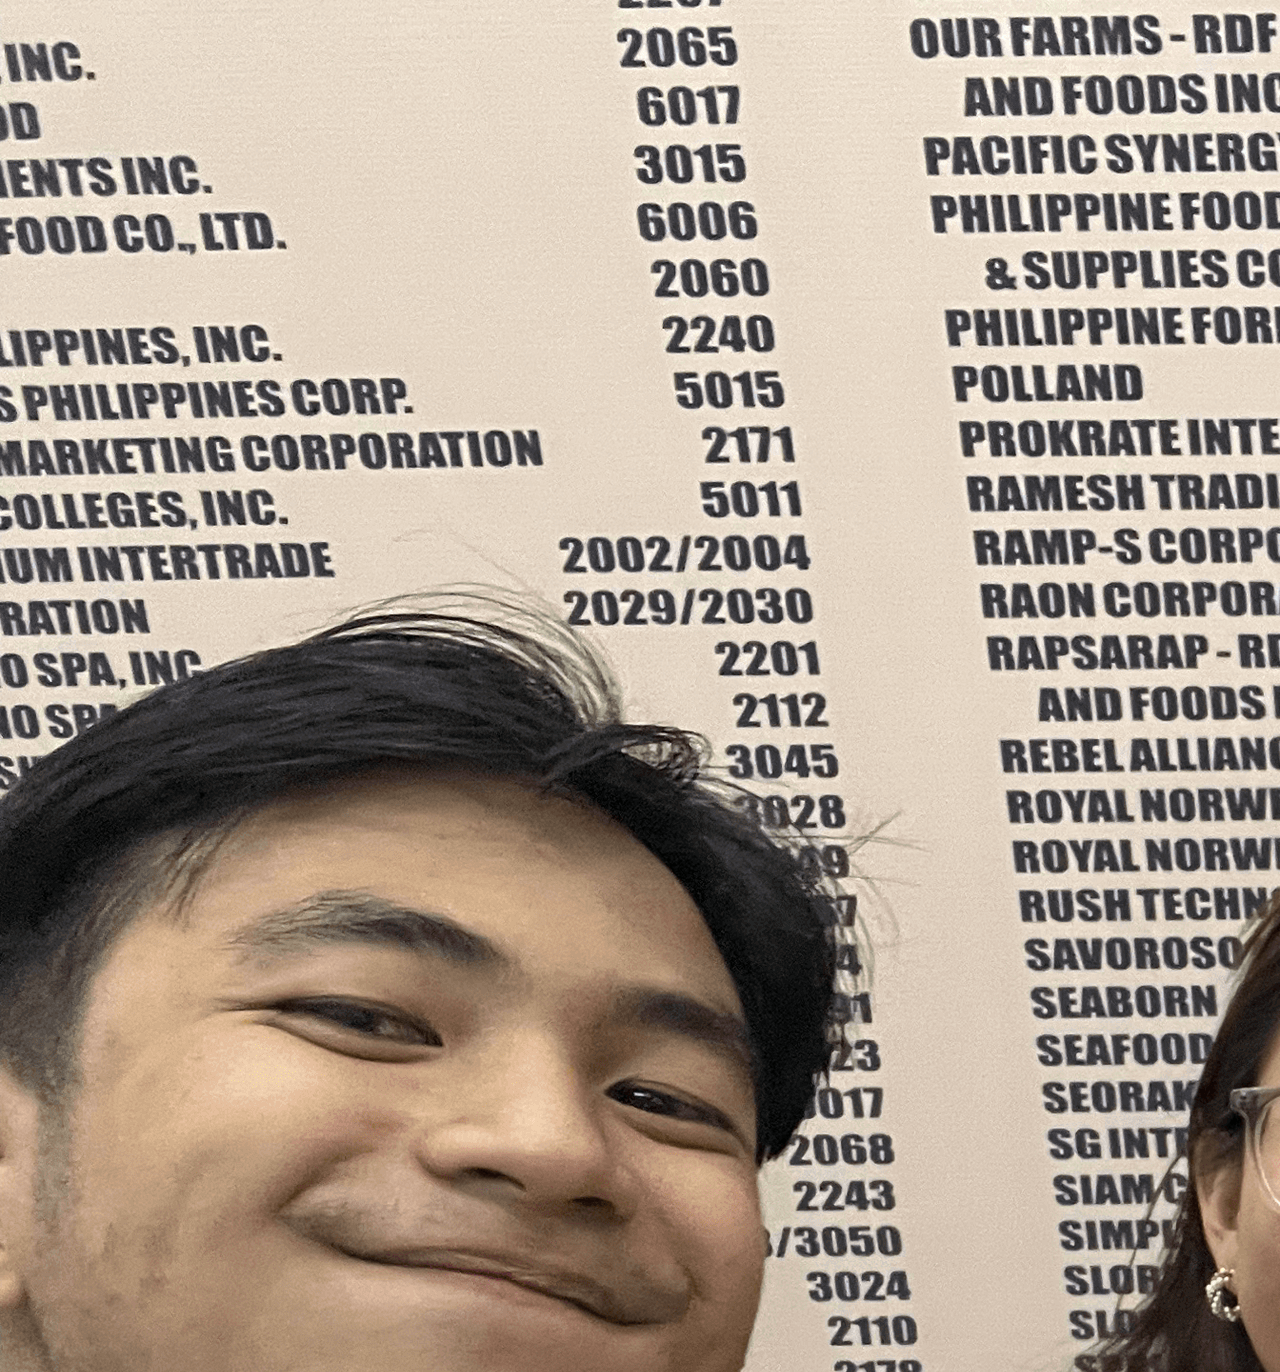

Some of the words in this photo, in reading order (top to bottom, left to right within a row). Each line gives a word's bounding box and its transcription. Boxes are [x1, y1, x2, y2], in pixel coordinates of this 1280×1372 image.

[617, 26, 738, 67] 2065
[910, 18, 1003, 59] OUR
[1009, 15, 1162, 56] FARMS
[1192, 13, 1277, 53] RDF
[4, 42, 95, 82] INC.
[964, 77, 1053, 117] AND
[1061, 74, 1208, 115] FOODS
[923, 135, 1097, 175] PACIFIC
[930, 193, 1174, 233] PHILIPPINE
[113, 214, 196, 255] CO.,
[199, 212, 287, 251] LTD.
[985, 258, 1017, 290] &
[1022, 249, 1229, 290] SUPPLIES
[662, 315, 775, 353] 2240
[945, 308, 1185, 346] PHILIPPINE
[21, 380, 285, 421] PHILIPPINES
[290, 378, 413, 416] CORP.
[952, 364, 1143, 402] POLLAND
[0, 436, 235, 476] MARKETING
[241, 430, 543, 472] CORPORATION
[959, 419, 1182, 457] PROKRATE
[199, 489, 288, 526] INC.
[700, 481, 802, 518] 5011
[966, 474, 1145, 512] RAMESH
[559, 535, 811, 573] 2002/2004
[973, 528, 1142, 565] RAMP-S
[563, 589, 814, 626] 2029/2030
[715, 641, 820, 676] 2201
[733, 692, 829, 727] 2112
[1000, 739, 1124, 773] REBEL
[1006, 789, 1135, 823] ROYAL
[1031, 985, 1217, 1019] SEABORN
[793, 1180, 896, 1211] 2243
[807, 1271, 911, 1302] 3024
[828, 1315, 917, 1346] 2110
